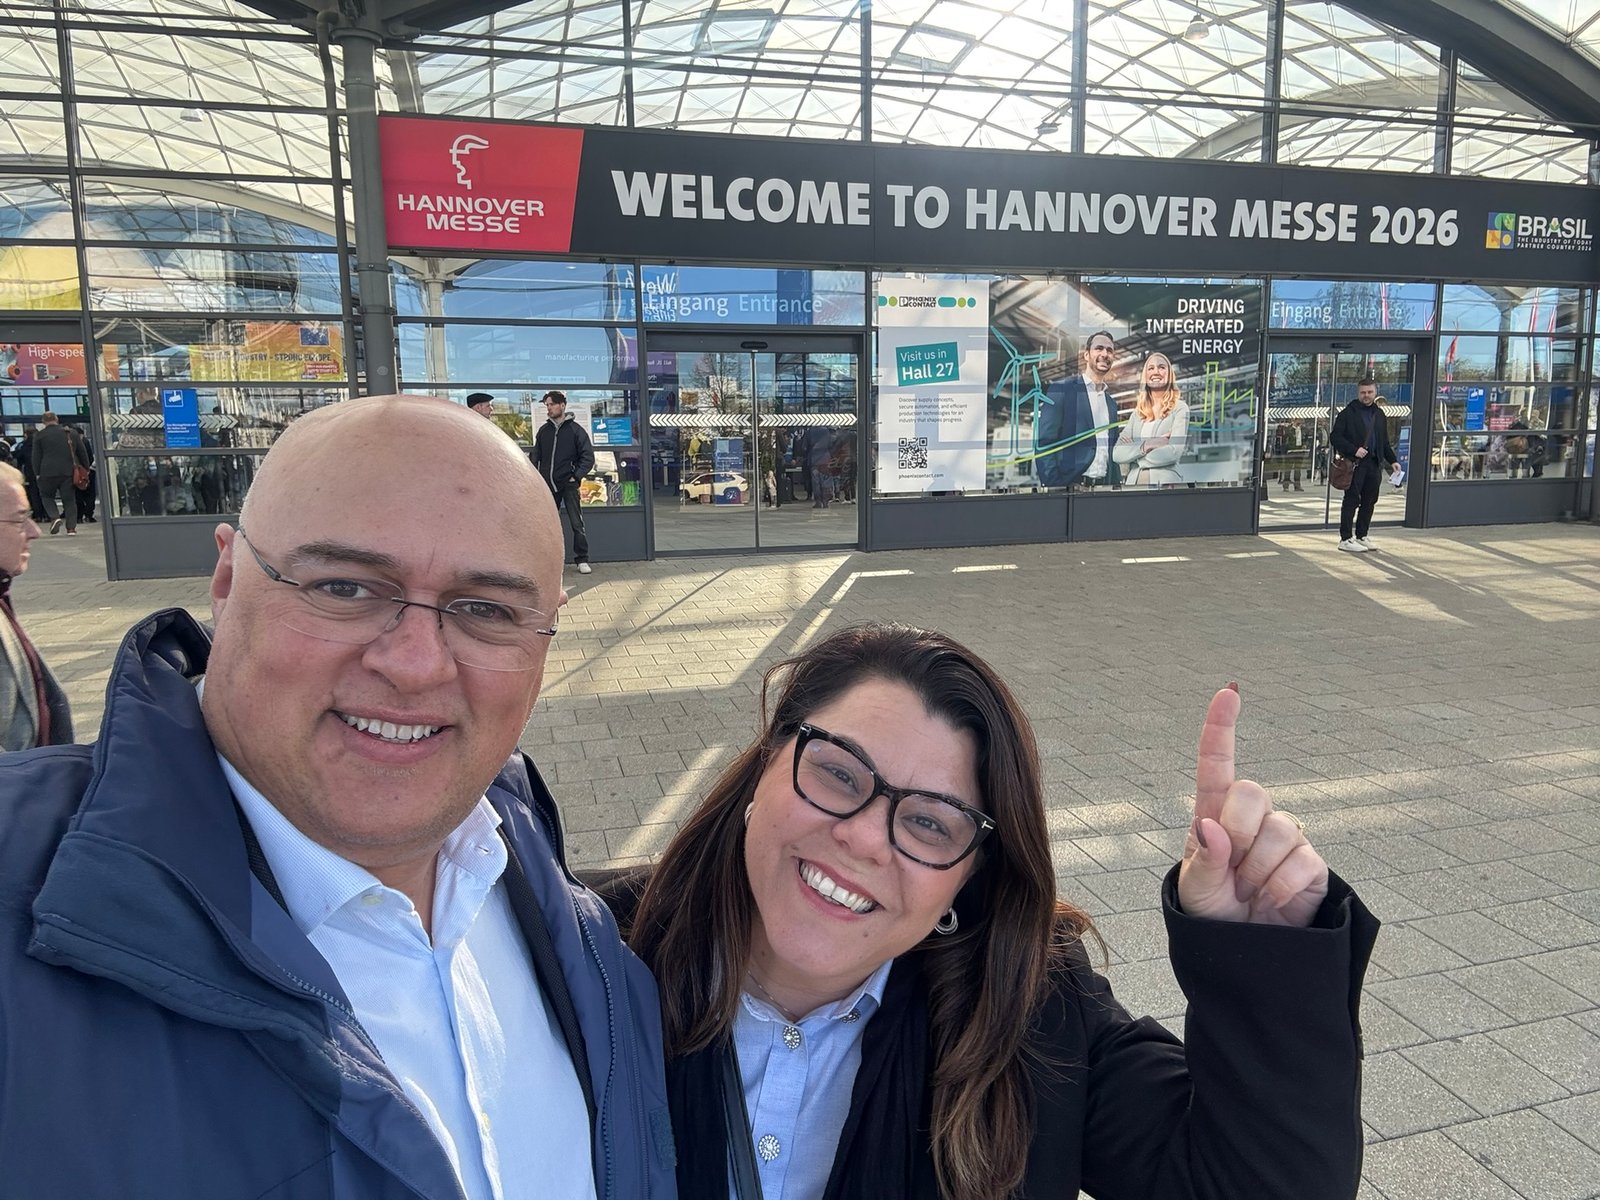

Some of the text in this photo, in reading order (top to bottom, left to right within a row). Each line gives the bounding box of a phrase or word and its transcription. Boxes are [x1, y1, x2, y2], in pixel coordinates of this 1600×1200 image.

[397, 193, 545, 217] HANNOVER
[611, 169, 1459, 247] WELCOME TO HANNOVER MESSE 2026
[426, 213, 520, 234] MESSE
[1517, 215, 1593, 239] BRASIL
[649, 294, 729, 318] Eingang
[739, 294, 823, 314] Entrance
[1177, 298, 1245, 314] DRIVING
[1272, 301, 1403, 324] Eingang Entrance
[1145, 318, 1244, 334] INTEGRATED
[900, 348, 947, 362] Visit us in
[1182, 339, 1244, 354] ENERGY
[544, 354, 599, 363] manufacturing
[902, 362, 954, 381] Hall 27
